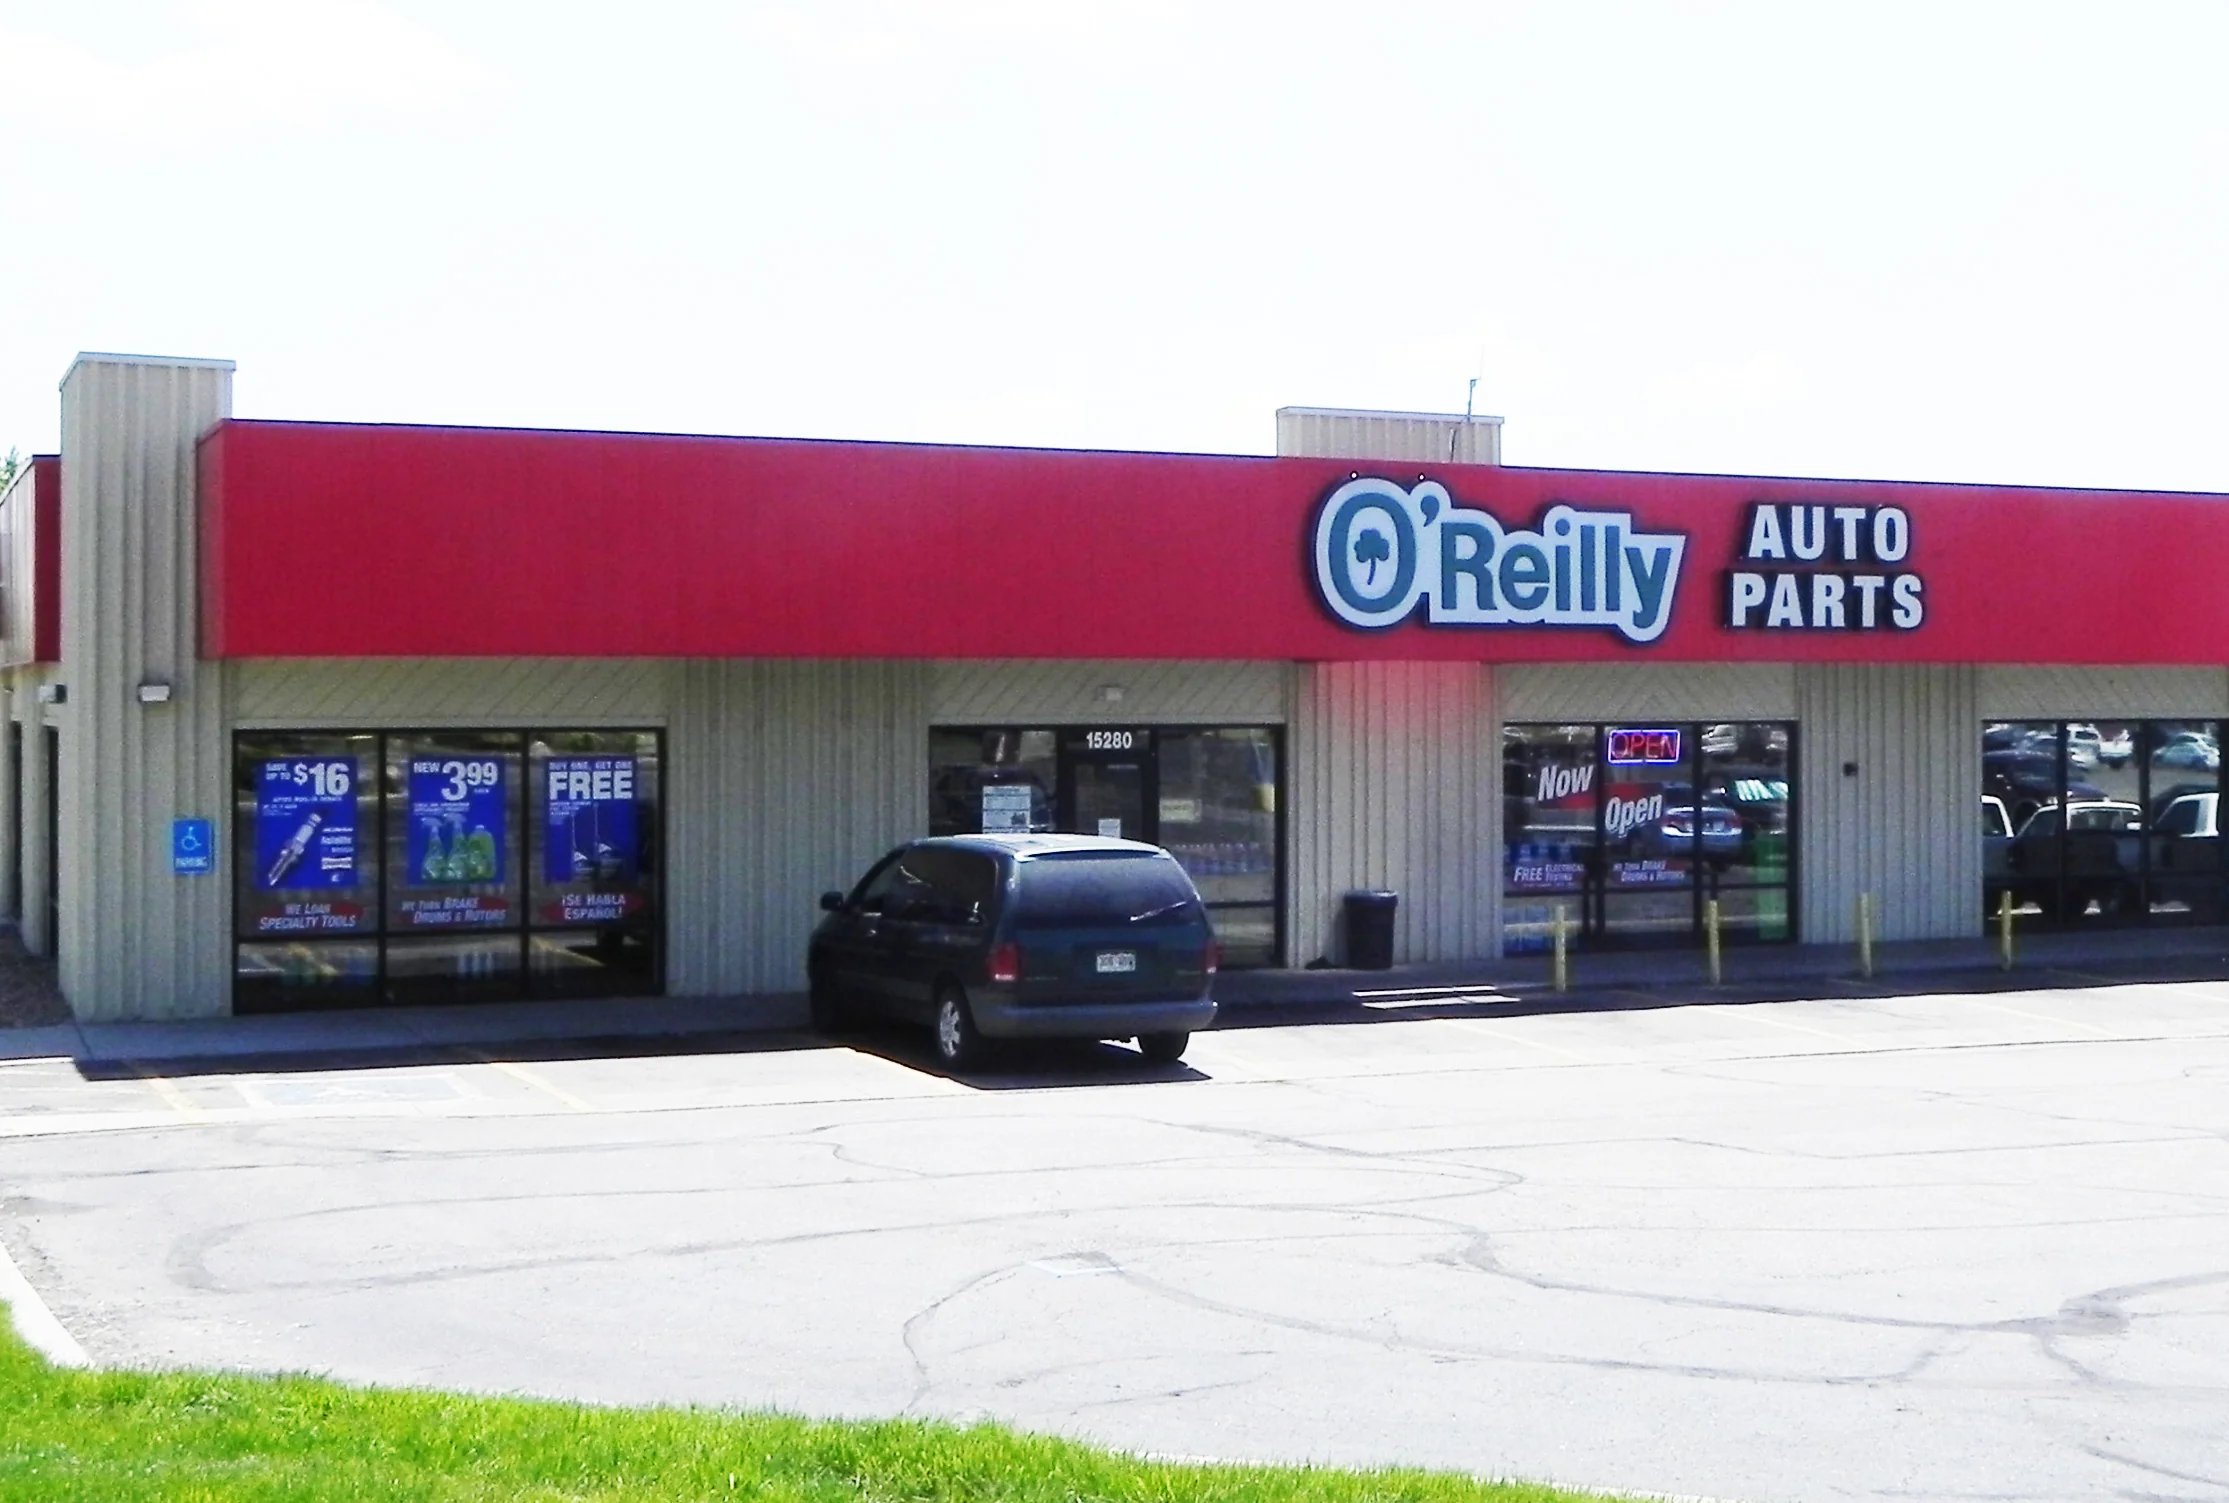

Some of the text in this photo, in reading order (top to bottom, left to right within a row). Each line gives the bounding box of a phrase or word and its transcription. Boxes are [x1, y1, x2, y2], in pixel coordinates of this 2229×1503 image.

[1747, 503, 1911, 563] AUTO
[1326, 490, 1674, 629] O'Reilly
[1731, 571, 1925, 630] PARTS
[1085, 731, 1132, 750] 15280
[1612, 733, 1677, 760] OPEN
[293, 762, 350, 796] $16
[413, 762, 440, 773] NEW
[1538, 765, 1593, 802] Now
[549, 770, 633, 800] FREE
[1605, 794, 1663, 838] Open
[1514, 866, 1543, 882] FREE
[258, 914, 357, 930] SPECIALTY TOOLS
